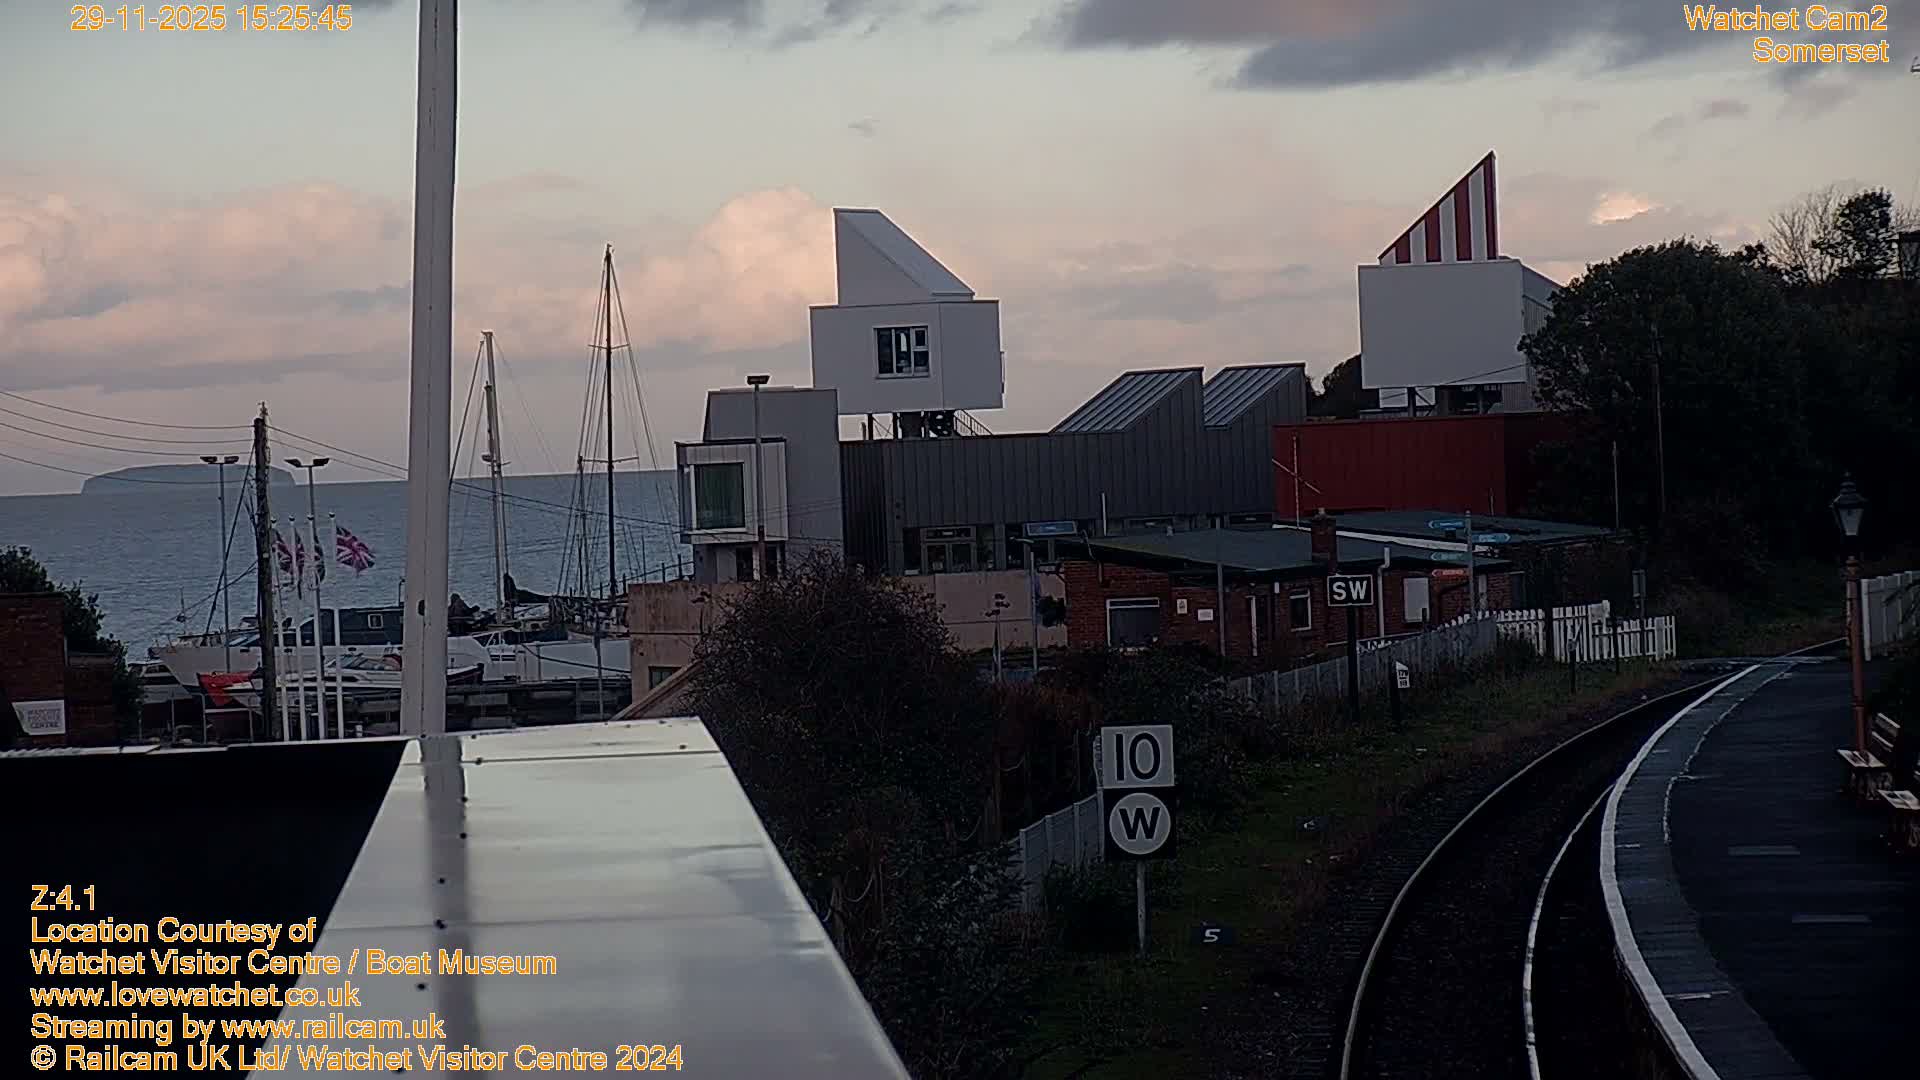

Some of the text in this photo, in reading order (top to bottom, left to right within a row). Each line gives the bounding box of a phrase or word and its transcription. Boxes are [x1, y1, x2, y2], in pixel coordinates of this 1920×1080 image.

[1332, 580, 1368, 601] SW
[1115, 732, 1161, 781] 10
[1118, 806, 1161, 840] W
